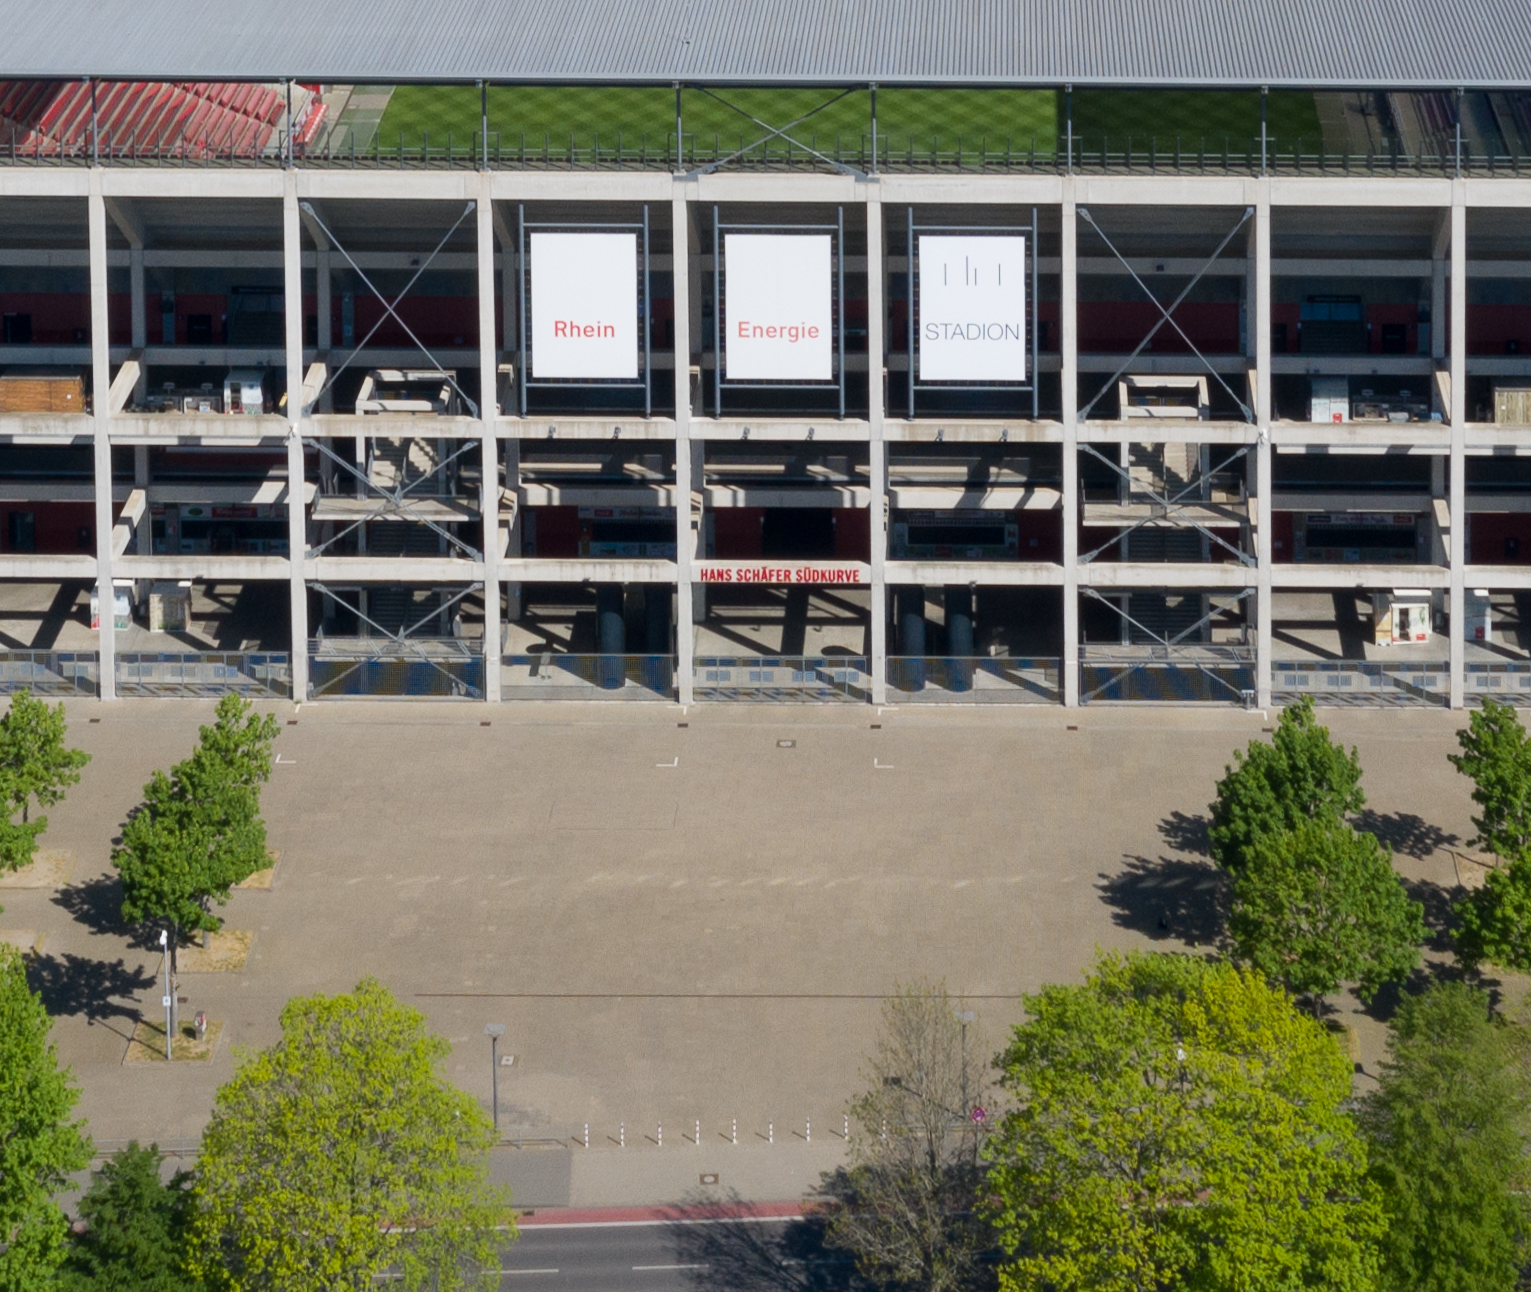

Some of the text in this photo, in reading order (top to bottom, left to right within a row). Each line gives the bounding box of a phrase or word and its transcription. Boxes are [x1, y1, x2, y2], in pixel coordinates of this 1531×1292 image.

[554, 320, 615, 338] Rhein
[738, 321, 819, 343] Energie
[925, 323, 1020, 341] STADION
[700, 566, 859, 583] HANS SCHÄFER SÜDKURVE
